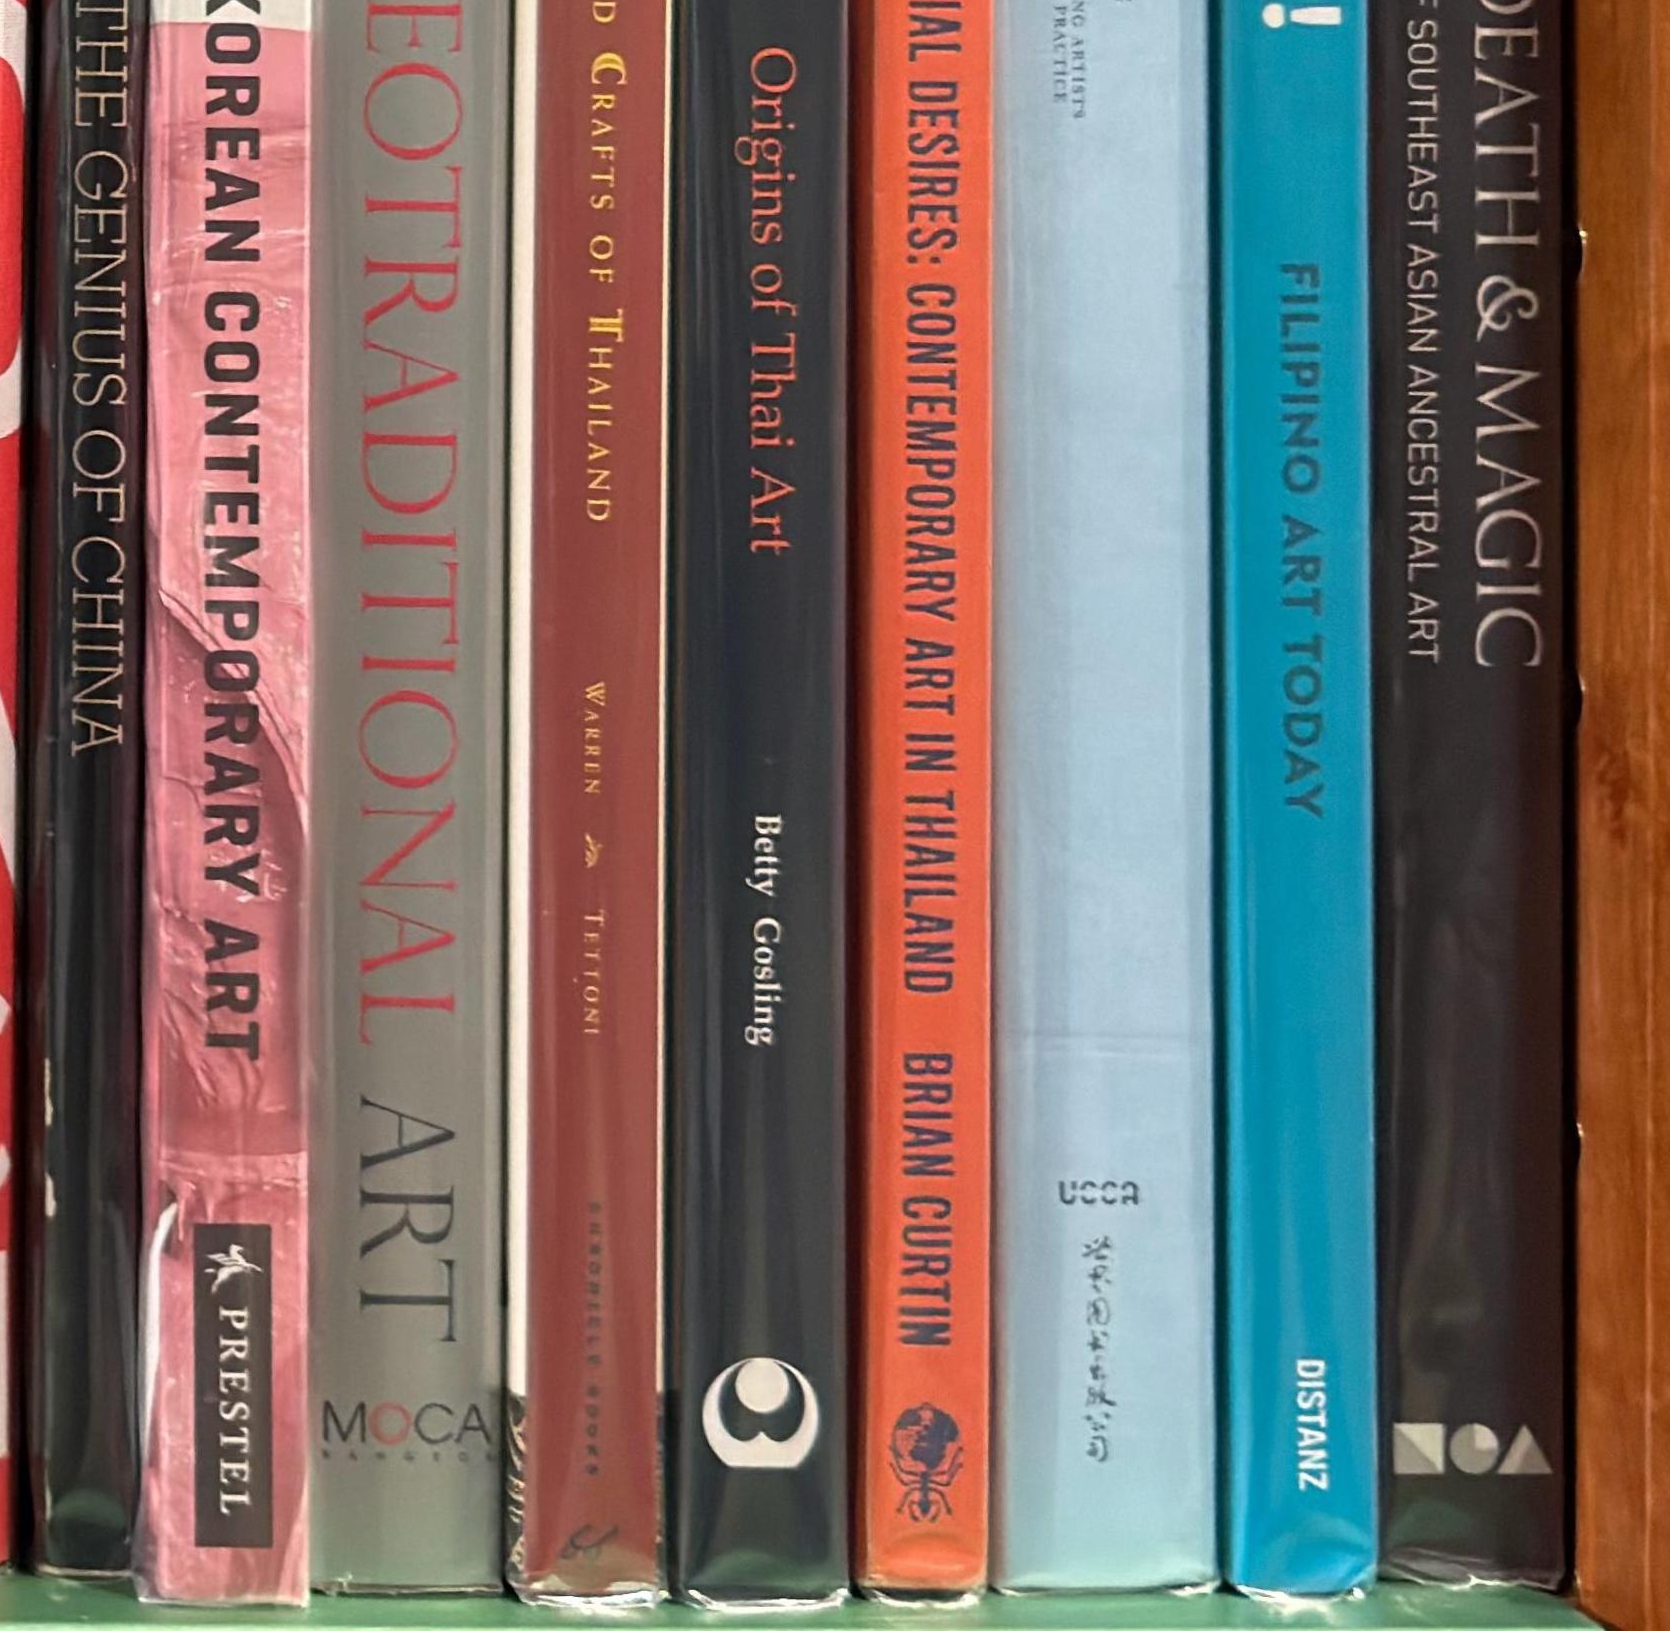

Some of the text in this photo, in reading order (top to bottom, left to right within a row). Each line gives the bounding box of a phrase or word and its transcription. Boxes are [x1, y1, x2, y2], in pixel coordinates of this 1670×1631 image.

[587, 52, 628, 209] CRAFTS
[904, 82, 958, 265] DESIRES:
[1405, 18, 1438, 241] SOUTHEAST
[72, 150, 130, 409] GENIUS
[587, 235, 612, 283] OF
[736, 45, 798, 557] Origins of Thai Art
[1405, 245, 1442, 355] ASIAN
[1473, 275, 1539, 341] &
[69, 430, 130, 523] OF
[585, 308, 626, 522] THAILAND
[904, 284, 960, 624] CONTEMPORARY
[1408, 363, 1443, 584] ANCESTRAL
[1472, 361, 1543, 668] MAGIC
[69, 535, 128, 759] CHINA
[201, 292, 261, 898] CONTEMPORARY
[1278, 264, 1326, 819] FILIPINO ART TODAY
[1406, 593, 1441, 663] ART
[904, 635, 957, 716] ART
[904, 733, 957, 776] IN
[202, 920, 262, 1060] ART
[745, 814, 783, 1047] Betty Gosling
[903, 791, 957, 994] THAILAND
[356, 1094, 457, 1342] ART
[896, 1050, 955, 1347] BRIAN CURTIN
[216, 1306, 254, 1517] PRESTEL
